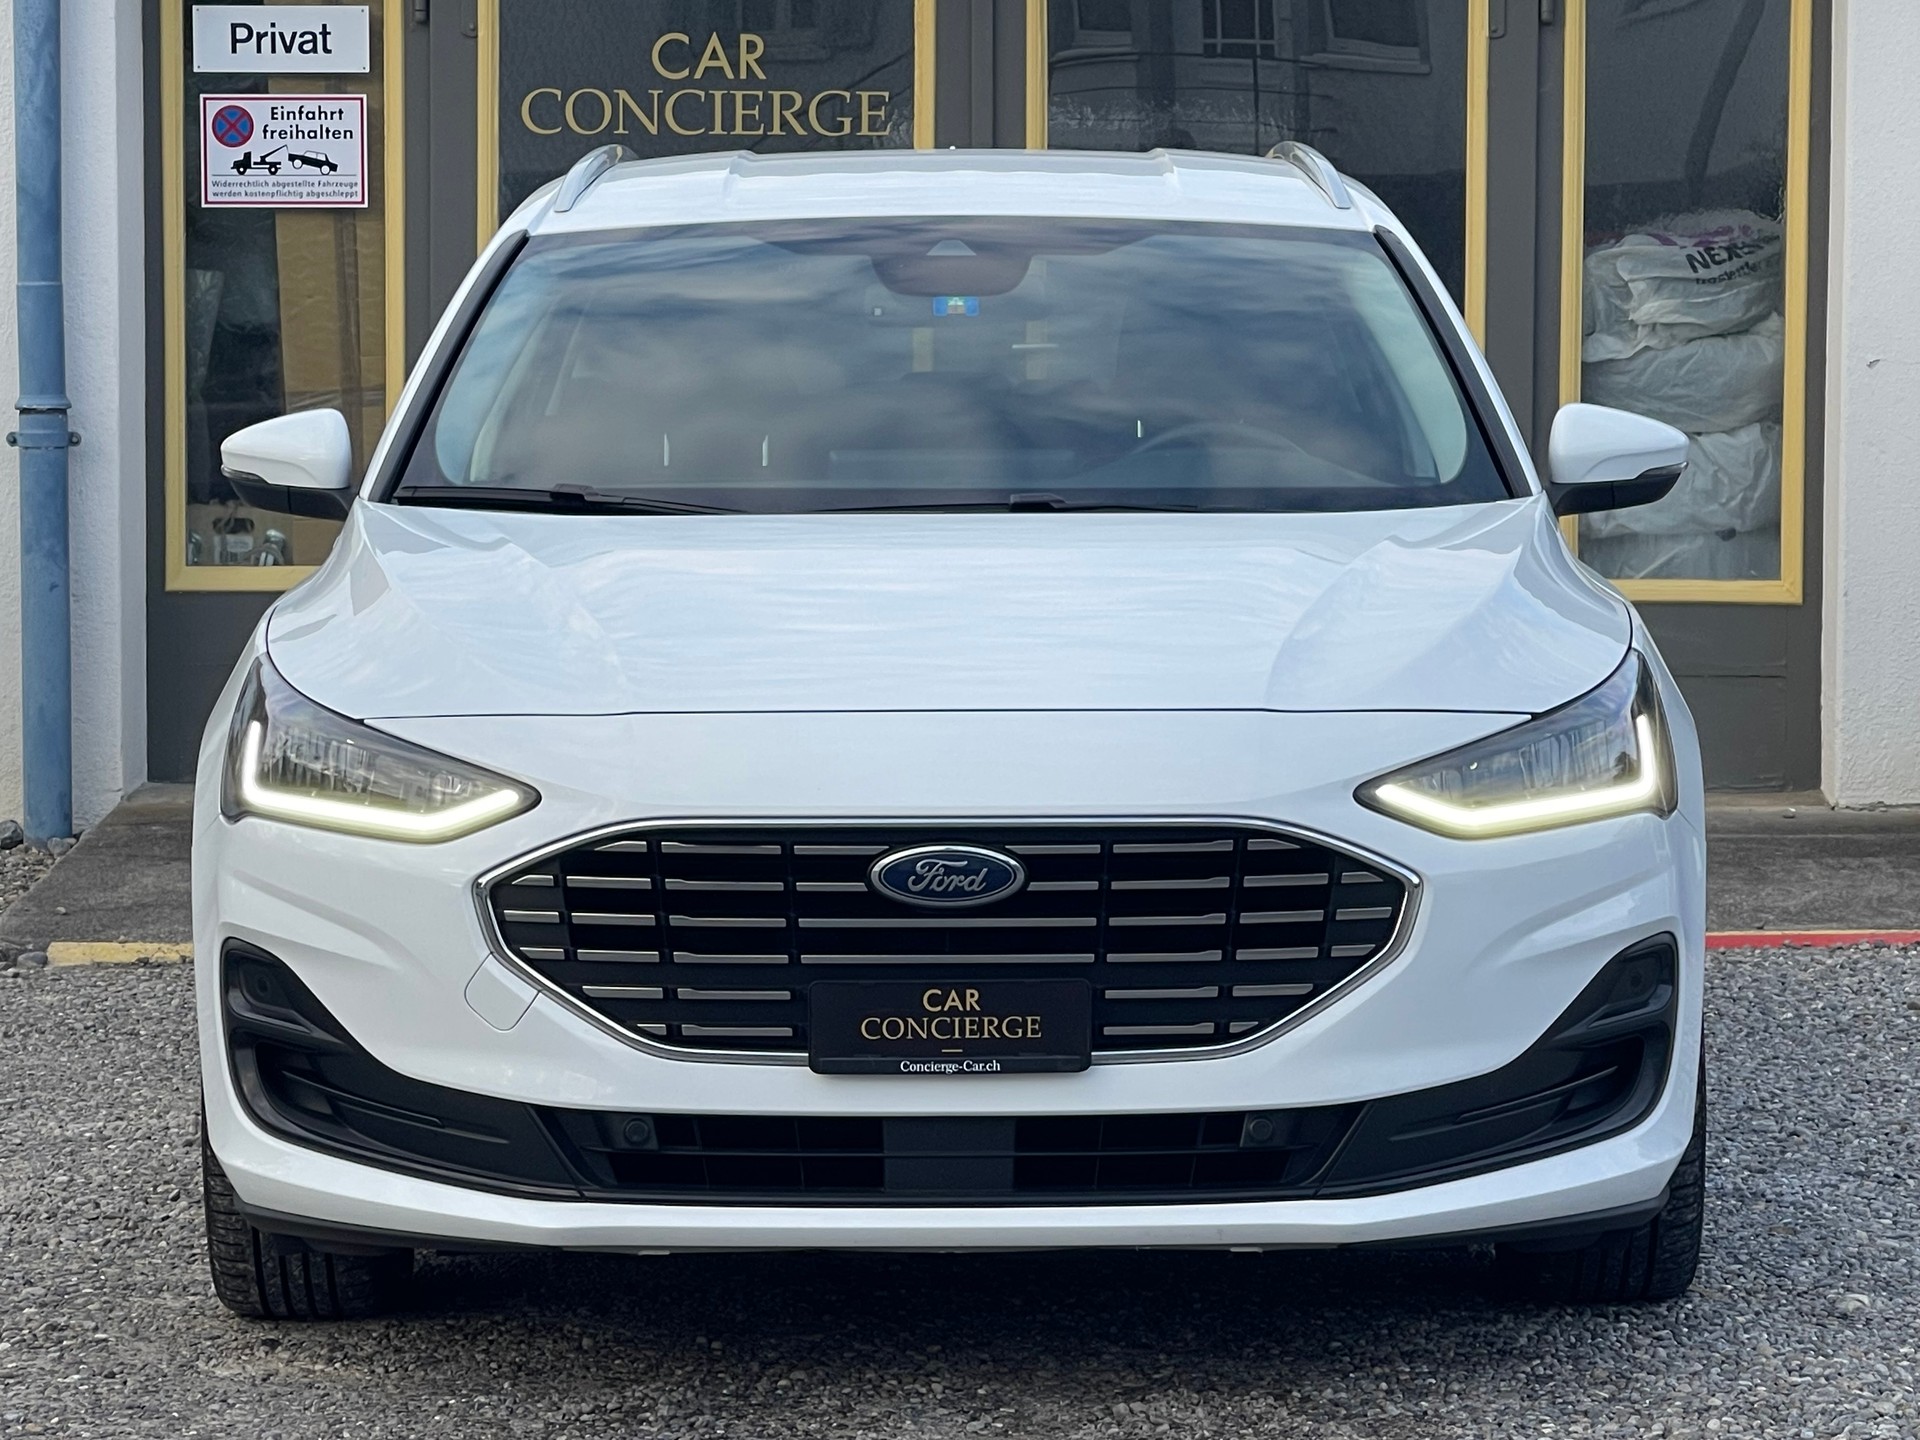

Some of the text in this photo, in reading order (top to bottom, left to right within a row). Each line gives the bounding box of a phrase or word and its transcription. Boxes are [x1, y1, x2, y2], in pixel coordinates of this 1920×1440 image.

[230, 22, 332, 55] Privat
[651, 31, 767, 80] CAR
[270, 104, 344, 121] Einfahrt
[520, 87, 890, 137] CONCIERGE
[262, 124, 353, 140] freihalten
[211, 180, 358, 190] Widerrechtlich abgestellte Fahrzeuge
[212, 189, 358, 199] werden kostenpflichtig abgeschleppt
[907, 859, 988, 892] Ford
[922, 988, 981, 1012] CAR
[860, 1015, 1043, 1040] CONCIERGE
[899, 1060, 1001, 1075] Concierge-Car.ch
